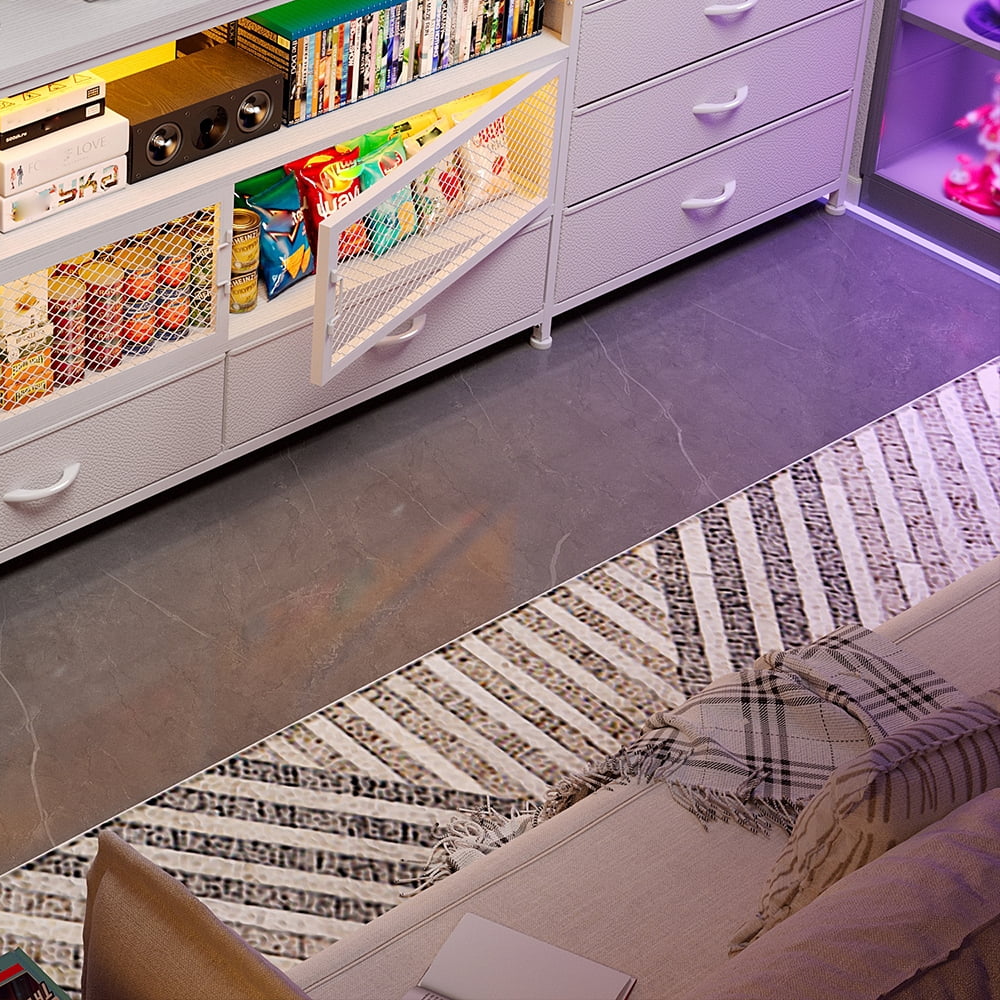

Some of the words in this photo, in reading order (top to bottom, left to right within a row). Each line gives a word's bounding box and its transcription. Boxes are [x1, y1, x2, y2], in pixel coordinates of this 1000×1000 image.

[76, 135, 107, 155] LOVE
[233, 229, 258, 245] HEINZ
[230, 273, 256, 288] HEINZ
